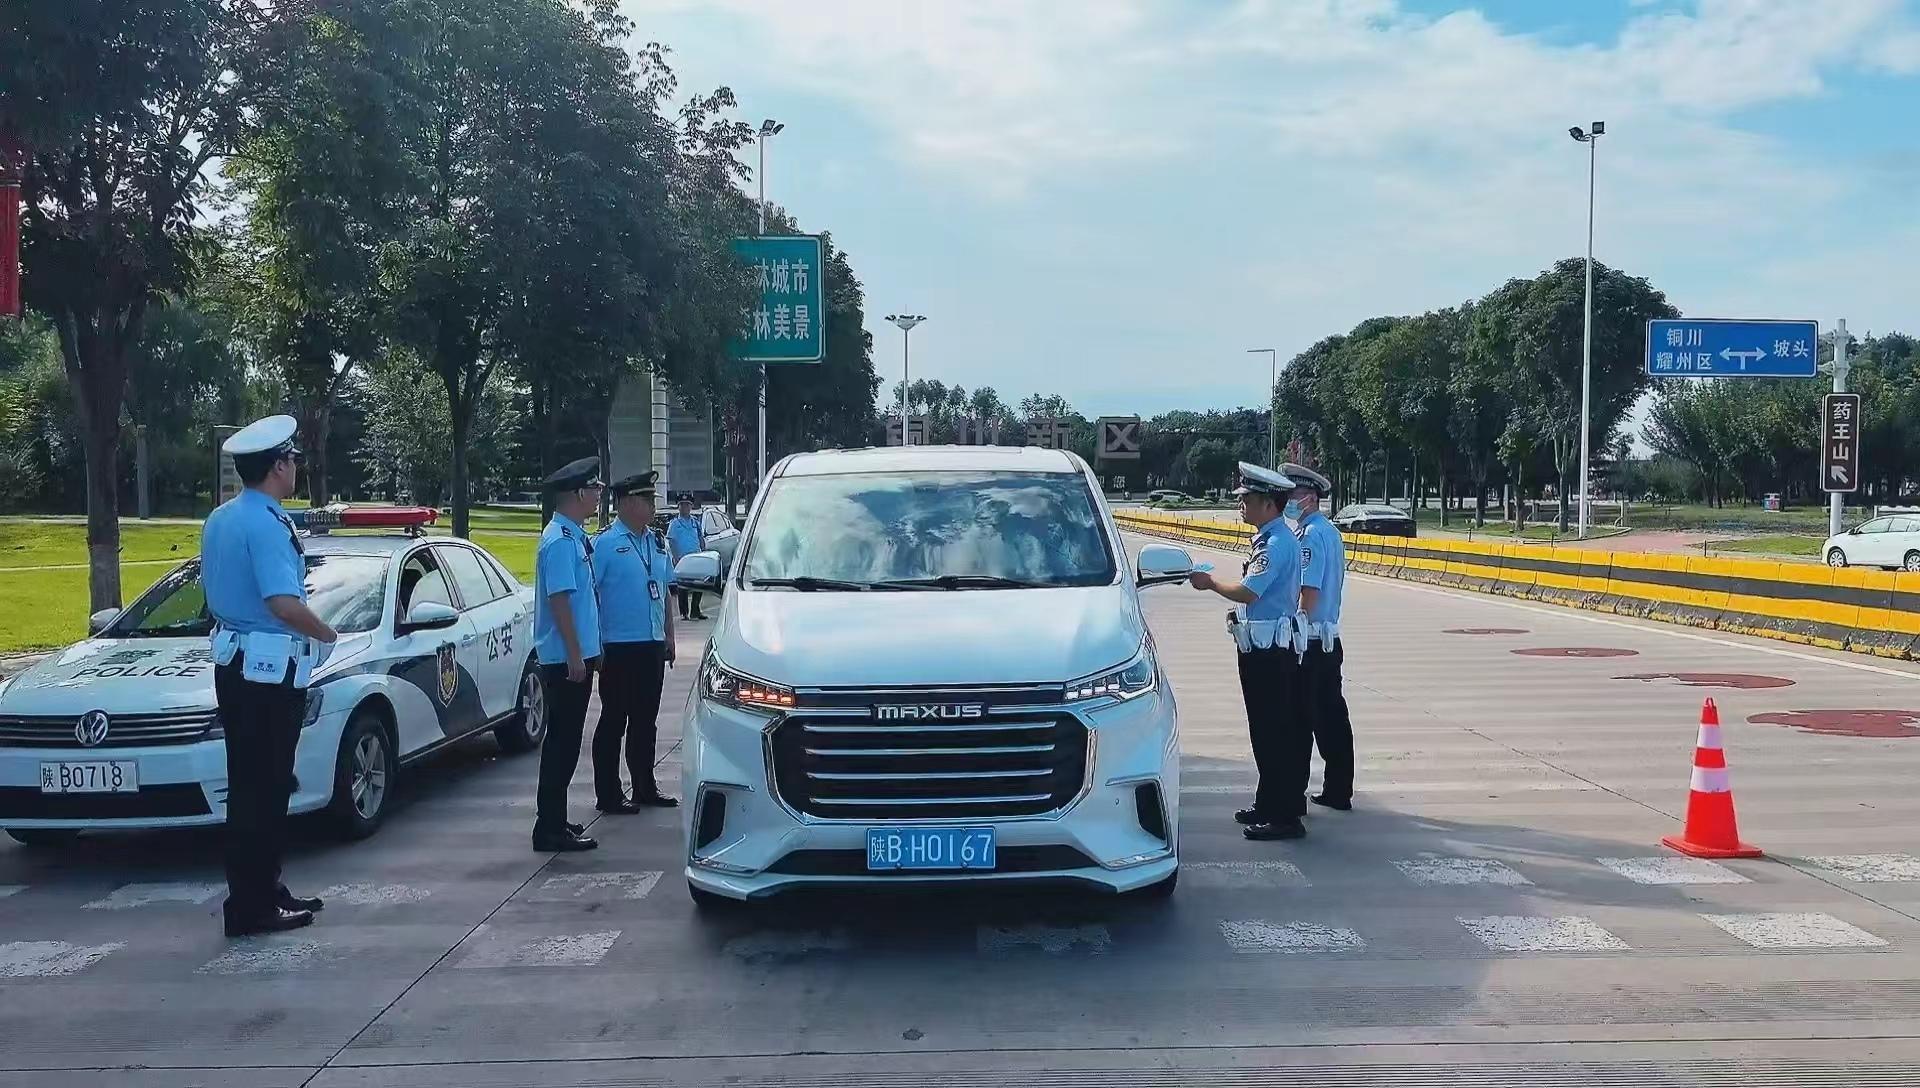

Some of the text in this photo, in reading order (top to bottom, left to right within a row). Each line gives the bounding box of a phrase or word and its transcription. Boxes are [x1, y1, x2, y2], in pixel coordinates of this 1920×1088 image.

[1667, 328, 1703, 346] 铜川
[1773, 339, 1810, 358] 坡头
[1656, 352, 1713, 370] 耀州区
[1831, 402, 1852, 461] 药王山
[486, 621, 513, 662] 公安
[71, 665, 207, 680] POLICE
[877, 704, 983, 719] MAXUS
